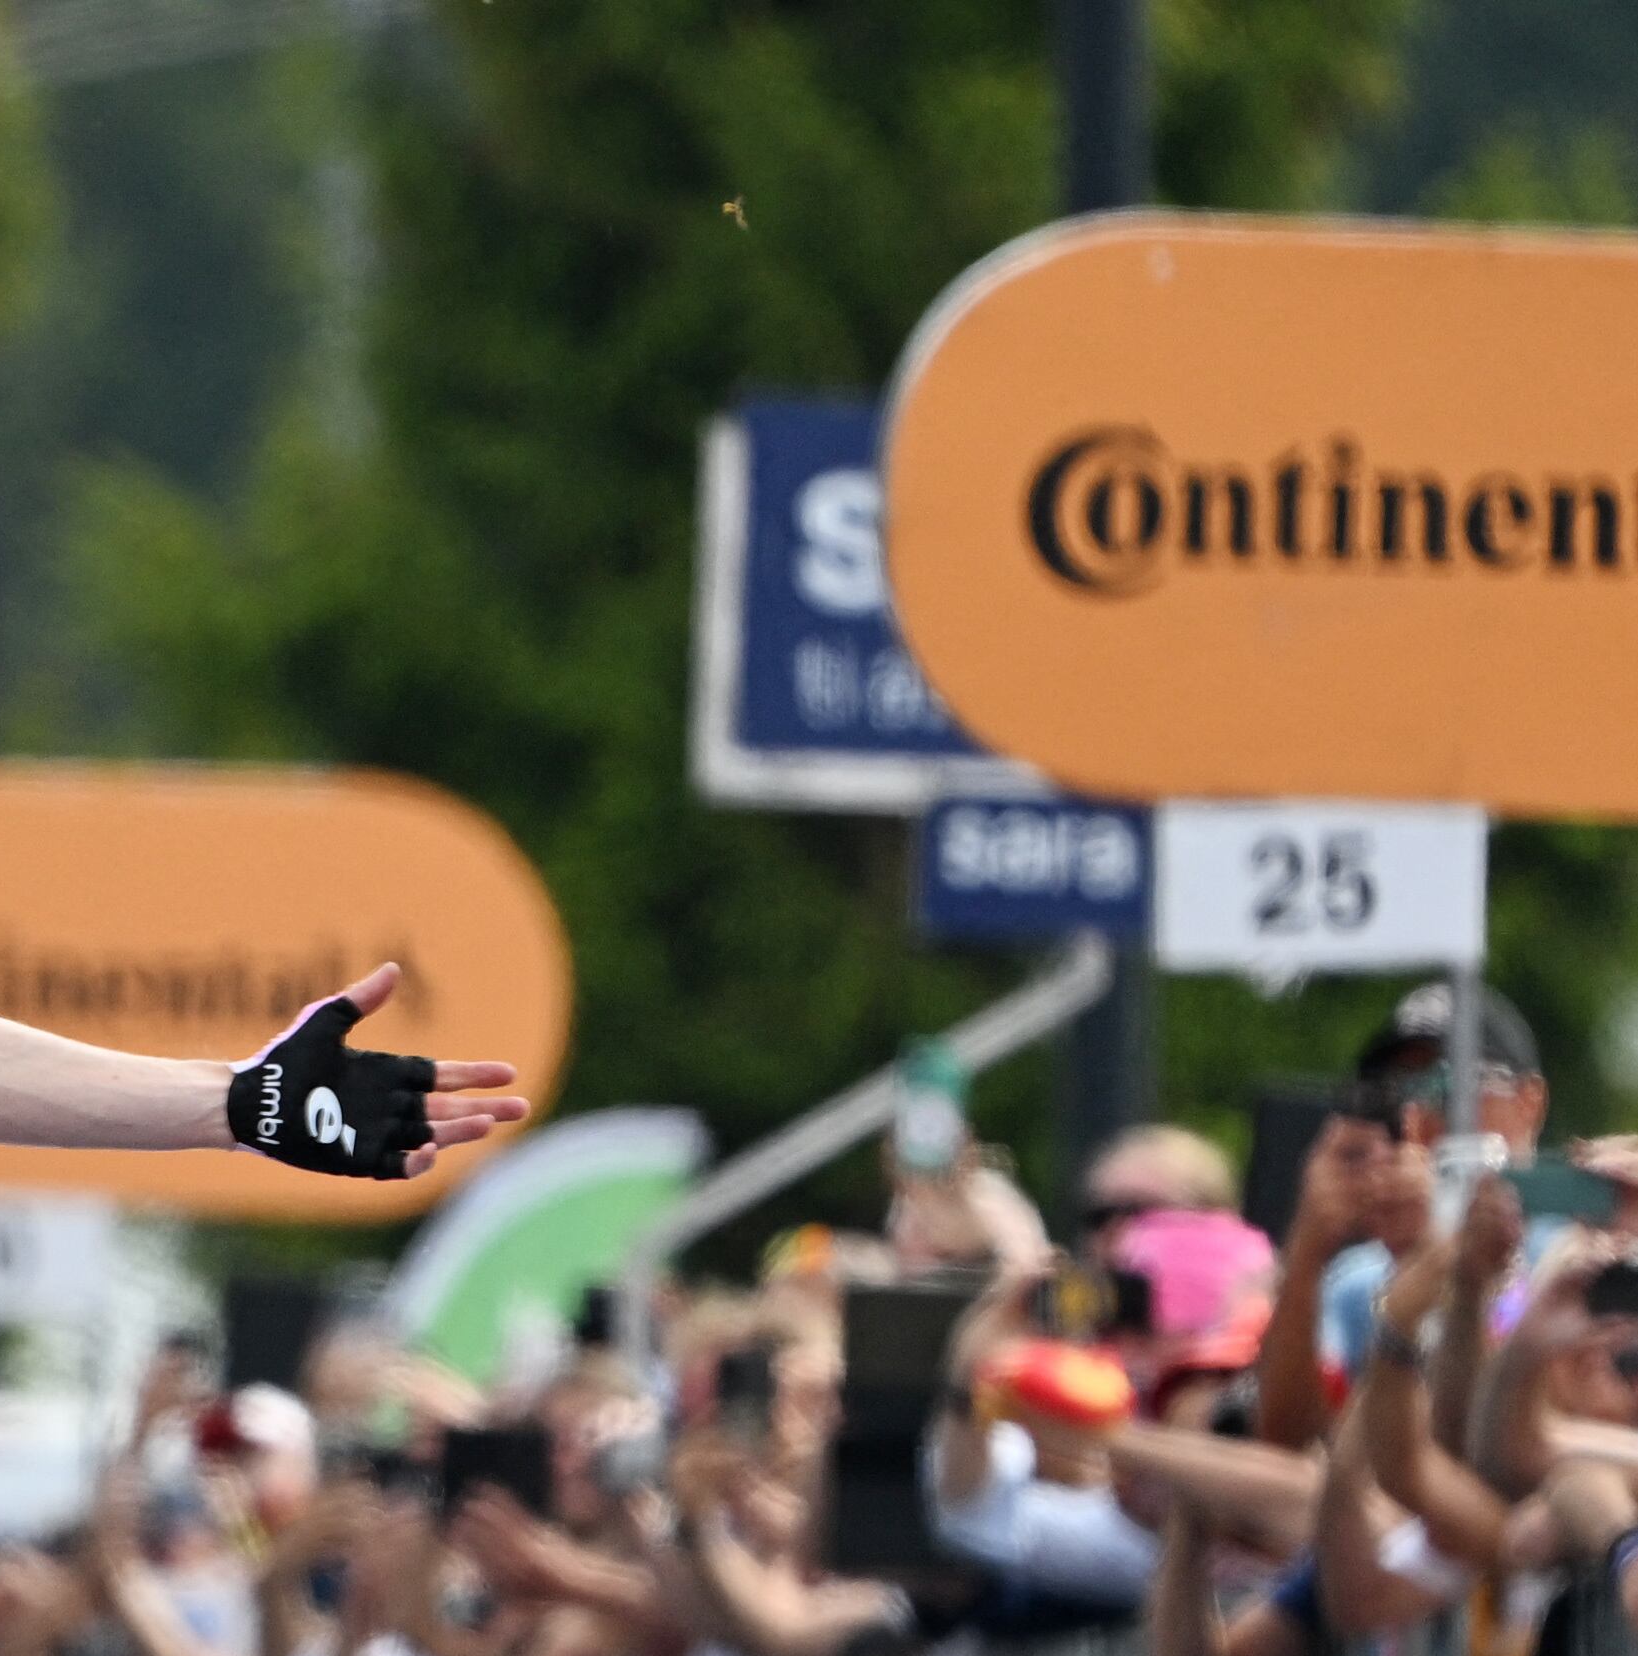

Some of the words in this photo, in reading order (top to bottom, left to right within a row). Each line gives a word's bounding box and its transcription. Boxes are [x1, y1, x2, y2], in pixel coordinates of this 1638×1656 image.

[1024, 420, 1638, 604] Continen
[1248, 835, 1380, 935] 25
[256, 1063, 284, 1145] nimbl
